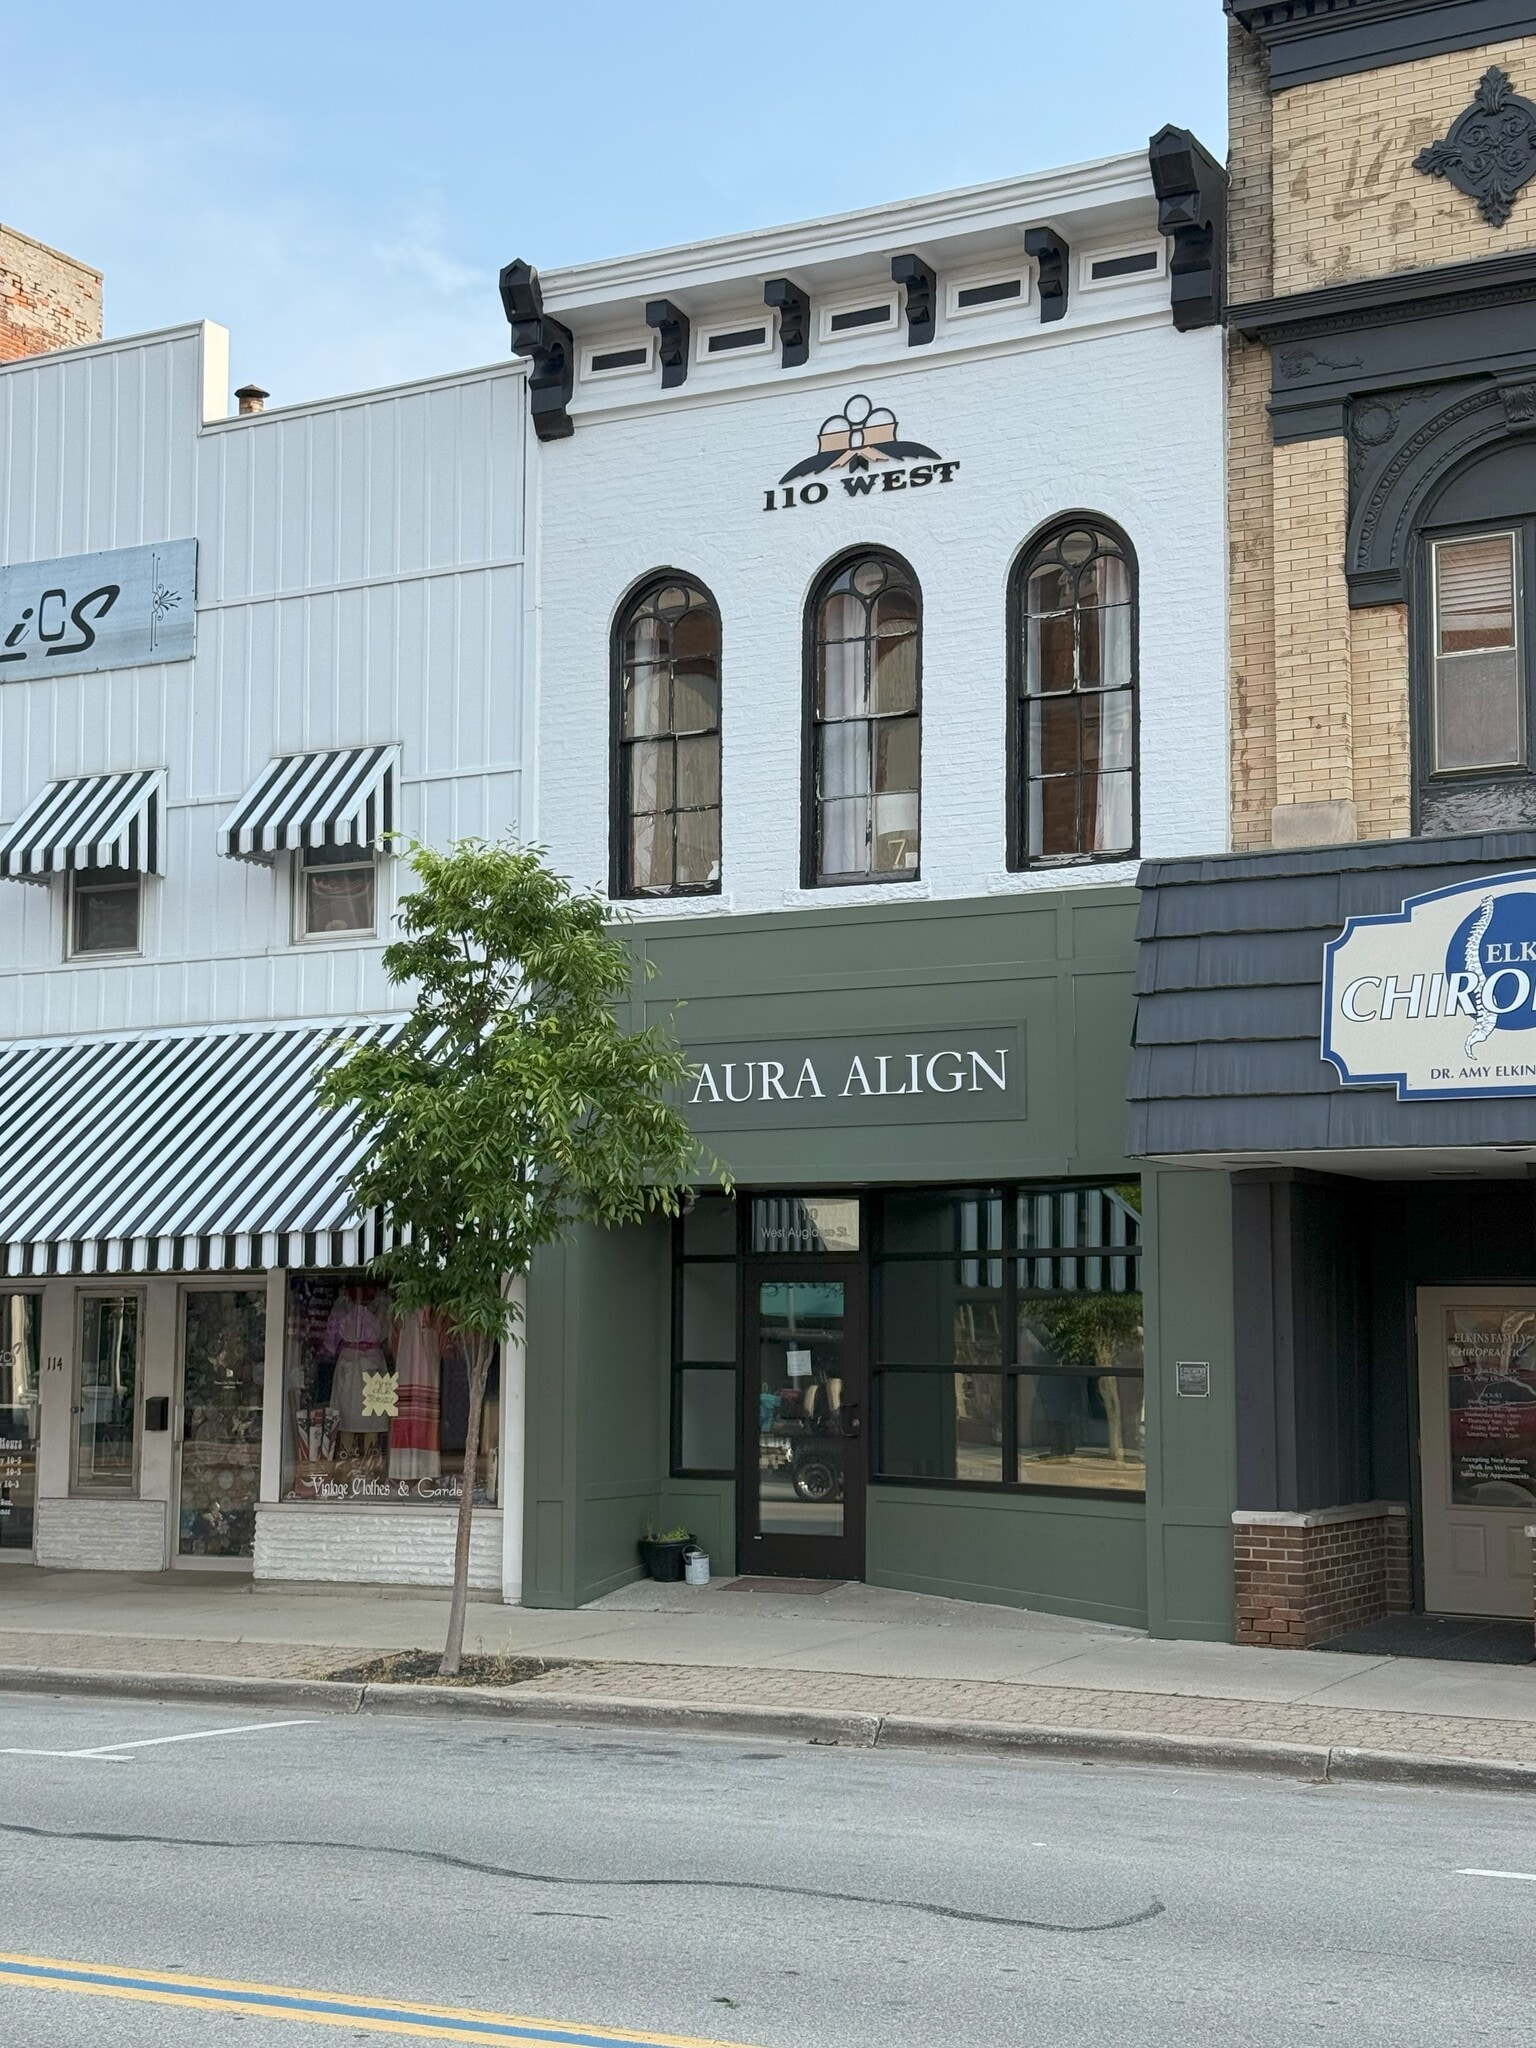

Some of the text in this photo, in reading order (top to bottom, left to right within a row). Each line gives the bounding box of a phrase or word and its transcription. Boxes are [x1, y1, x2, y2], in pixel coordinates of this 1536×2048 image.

[763, 461, 960, 511] 110 WEST
[1341, 968, 1536, 1022] CHIRO
[688, 1049, 1009, 1104] AURA ALIGN
[1430, 1069, 1454, 1080] DR.
[1459, 1067, 1491, 1079] AMY
[794, 1208, 819, 1221] 110
[761, 1227, 785, 1239] West
[1454, 1332, 1527, 1344] ELKINS FAMILY
[1450, 1347, 1522, 1358] CHIROPRACTIC
[47, 1356, 63, 1372] 114
[1461, 1456, 1490, 1465] Accepting
[1494, 1464, 1521, 1472] Welcome
[1460, 1470, 1476, 1478] Same
[1490, 1472, 1530, 1480] Appointments
[310, 1475, 464, 1500] Vintage Clothes & Garde
